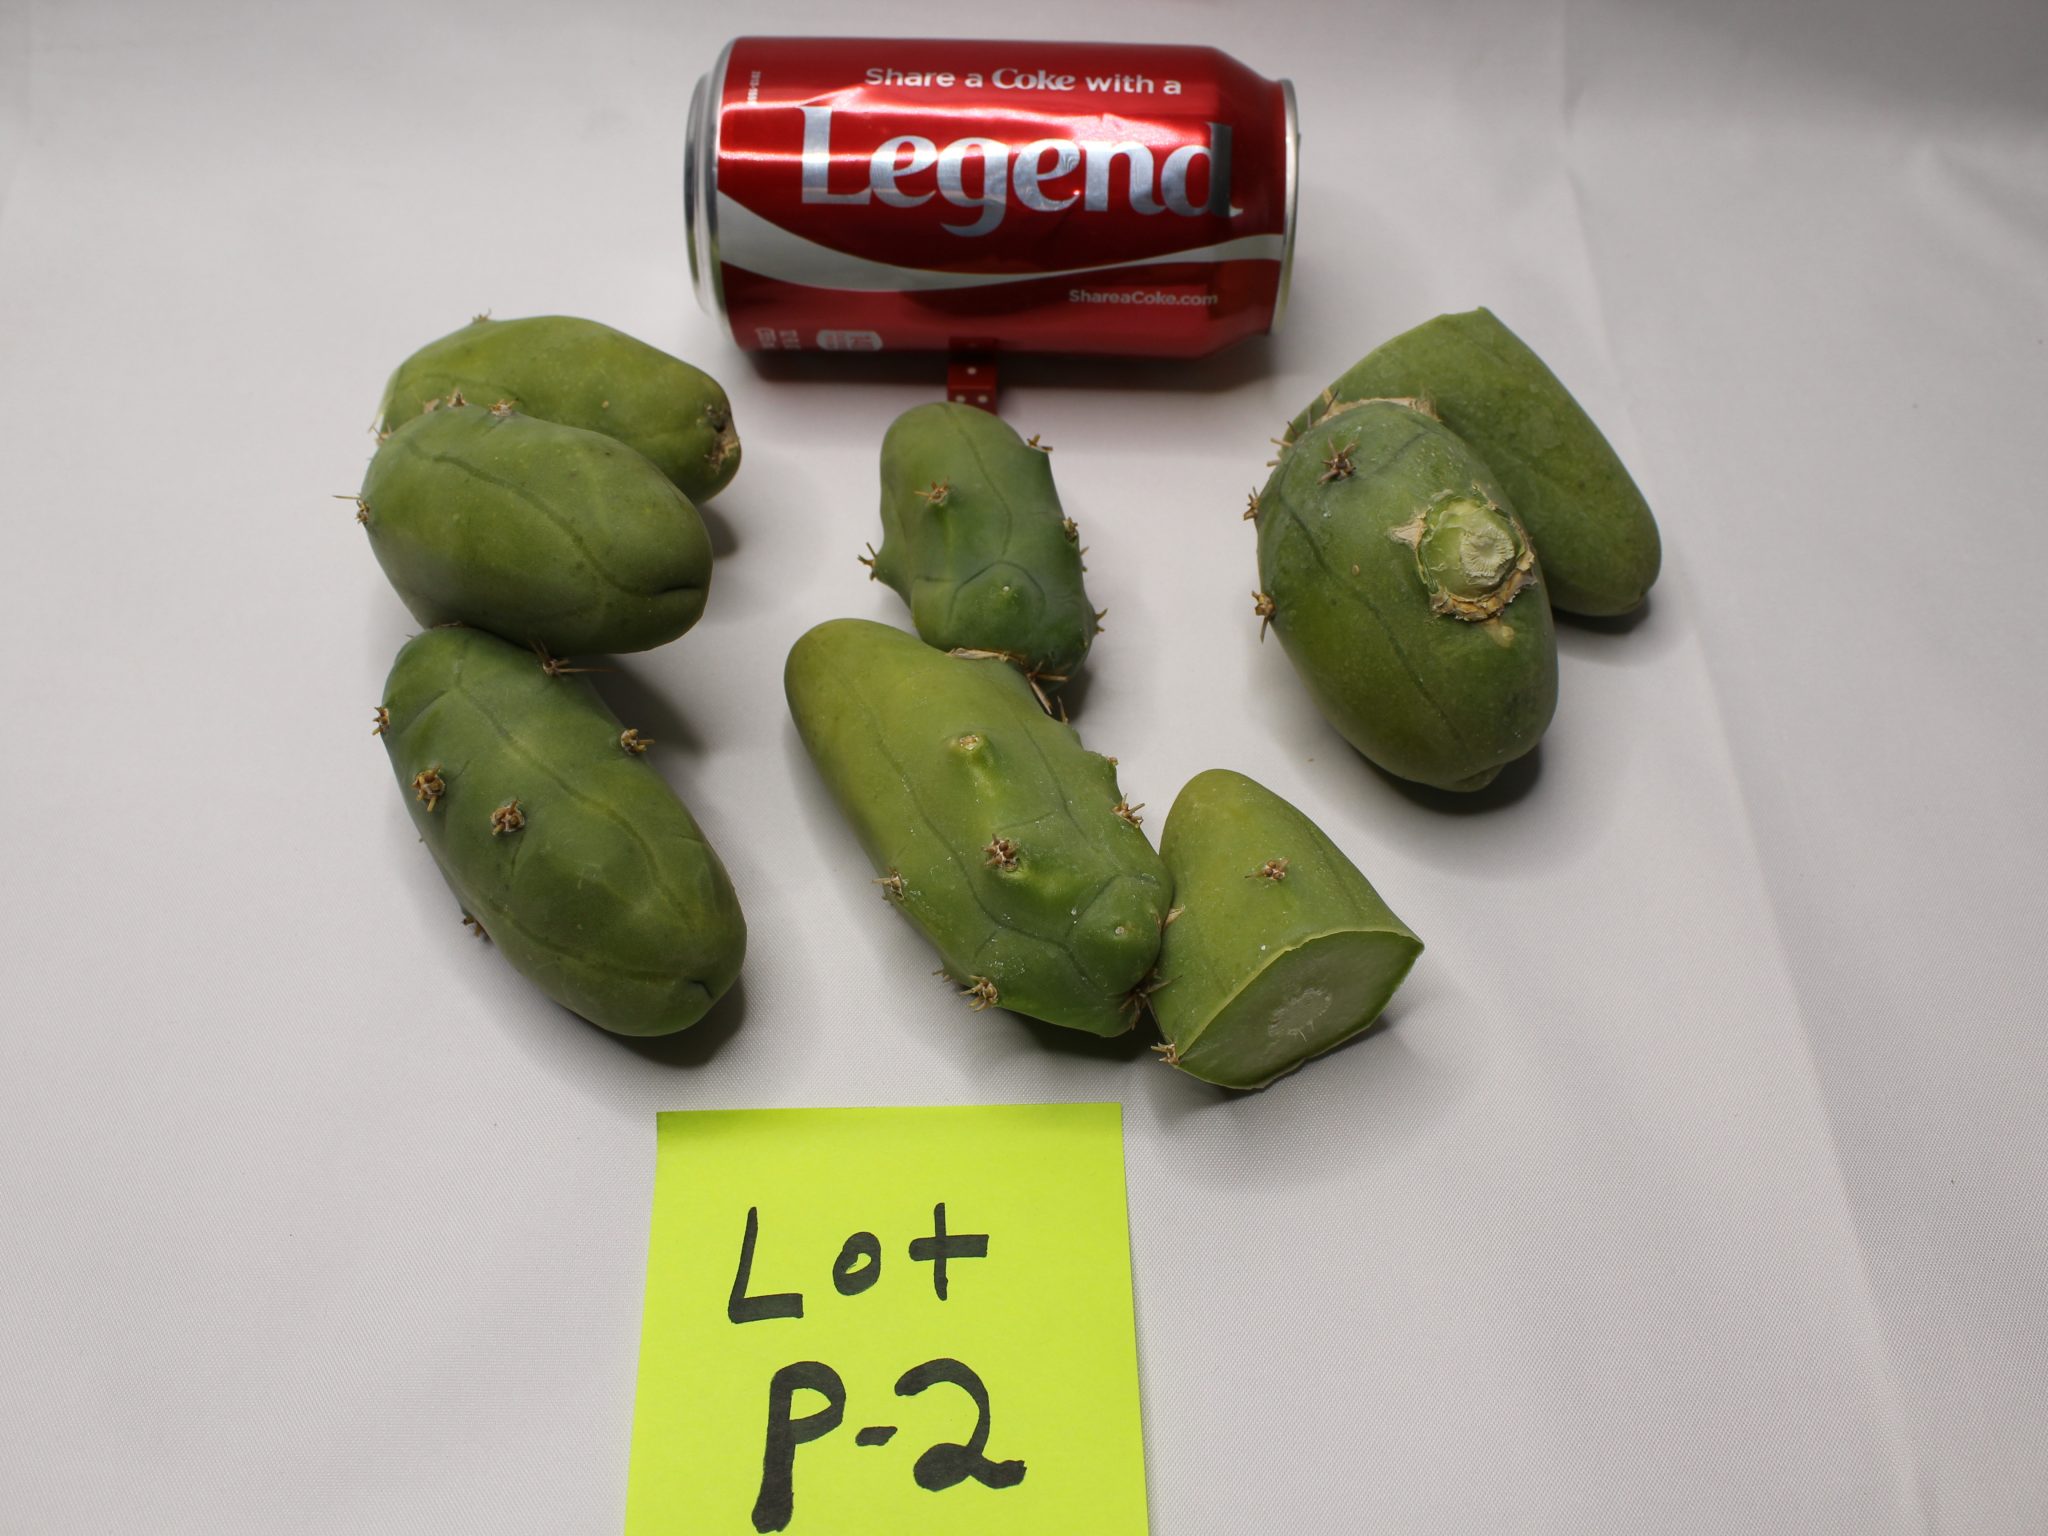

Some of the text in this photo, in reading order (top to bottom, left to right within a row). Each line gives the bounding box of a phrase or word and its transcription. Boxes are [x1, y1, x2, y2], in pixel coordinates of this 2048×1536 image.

[864, 67, 1182, 95] Share a Coke with a
[799, 105, 1244, 237] Legend
[1069, 289, 1218, 306] ShareaCoke.com
[728, 1202, 990, 1325] Lot
[751, 1358, 1028, 1534] P-2
